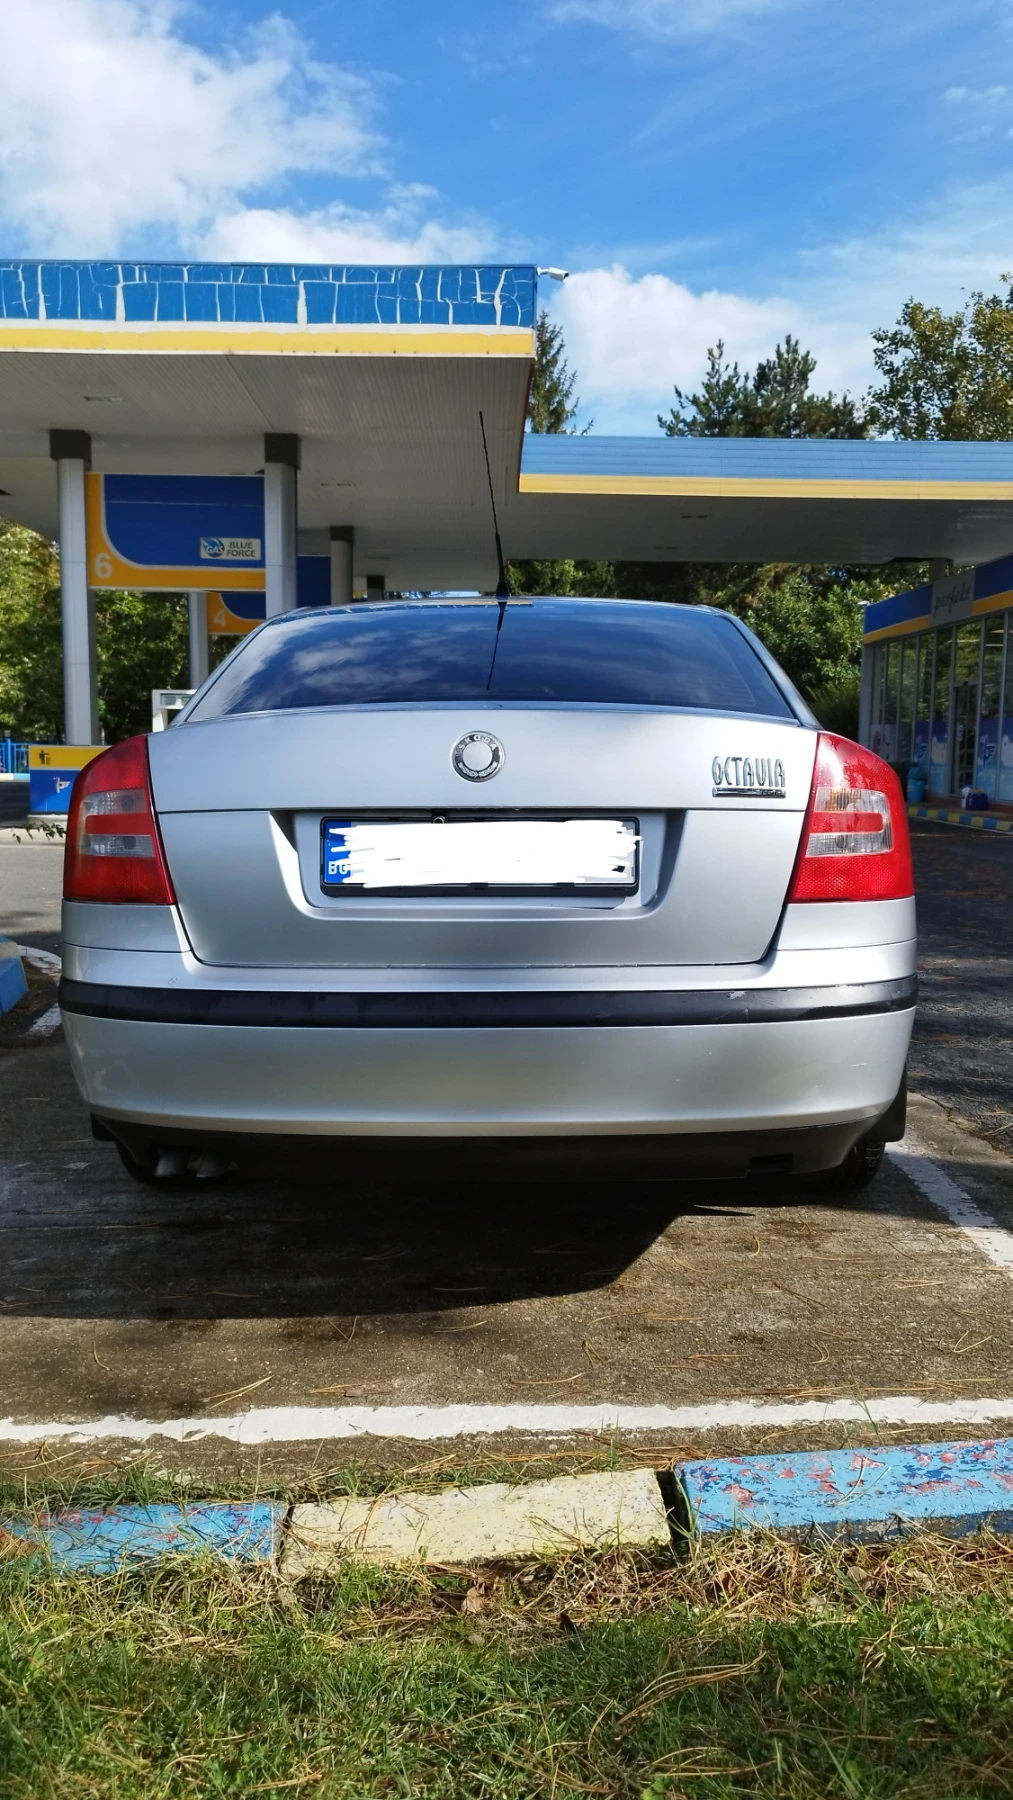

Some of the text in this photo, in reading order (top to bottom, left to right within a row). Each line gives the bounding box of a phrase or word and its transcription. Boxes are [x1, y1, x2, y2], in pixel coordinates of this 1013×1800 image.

[205, 545, 225, 554] GAS
[229, 541, 253, 549] BLUE
[94, 552, 112, 579] 6
[213, 610, 226, 628] 4
[712, 755, 786, 788] OCTAVIA
